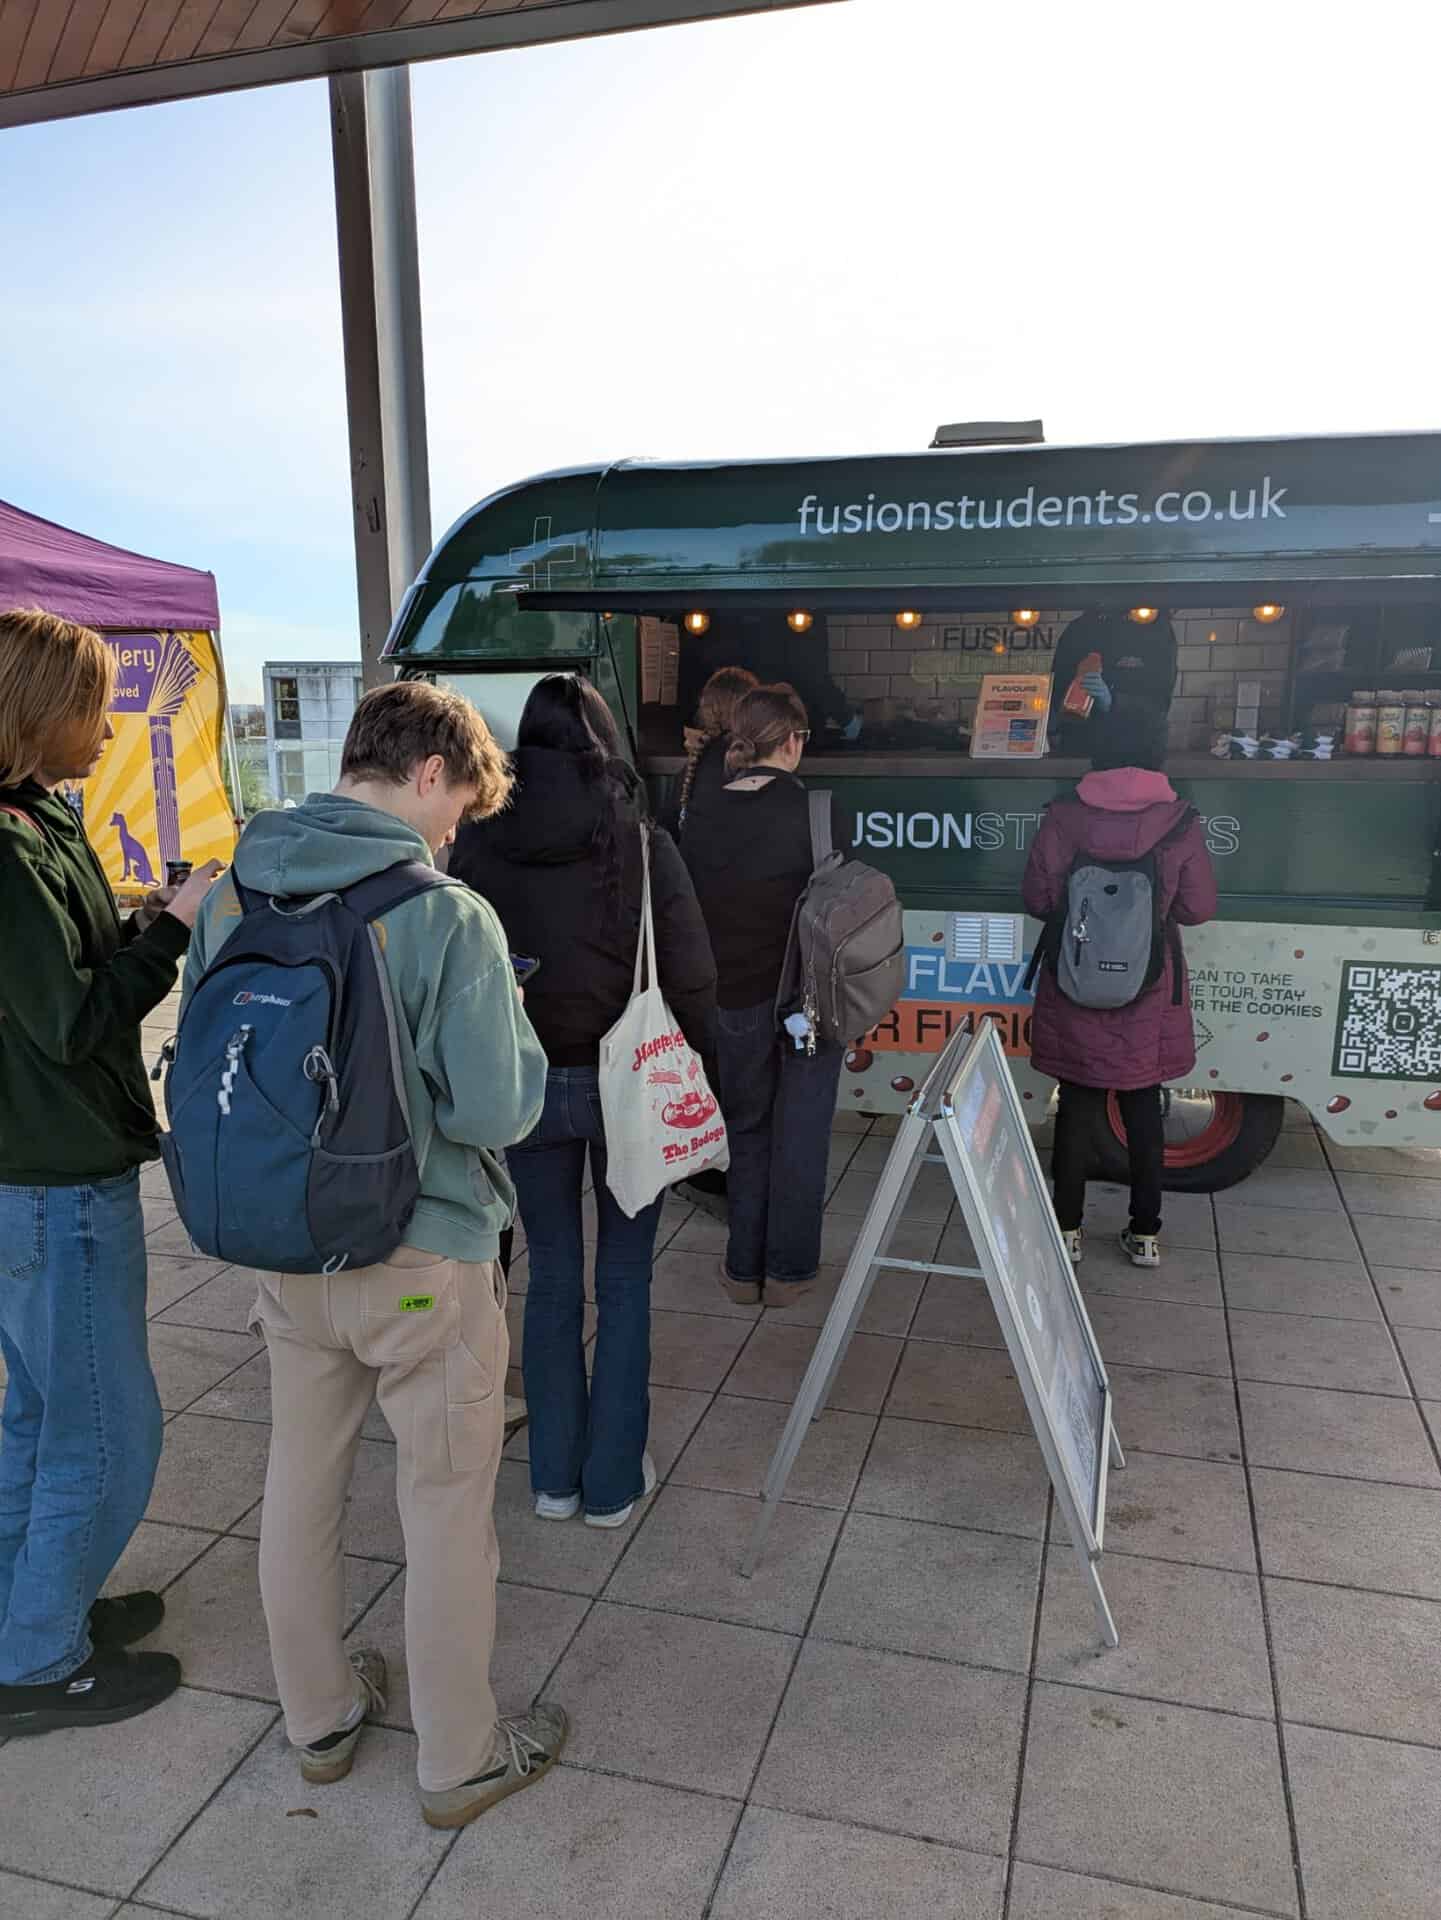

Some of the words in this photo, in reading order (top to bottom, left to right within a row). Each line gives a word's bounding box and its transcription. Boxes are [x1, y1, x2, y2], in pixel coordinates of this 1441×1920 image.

[797, 475, 1289, 535] fusionstudents.co.uk
[943, 626, 1054, 651] FUSION
[909, 954, 1037, 998] FLAV
[1186, 968, 1219, 982] CAN
[1223, 971, 1246, 984] TO
[1250, 971, 1295, 986] TAKE
[1262, 988, 1306, 1002] STAY
[1209, 1000, 1242, 1013] THE
[1246, 1001, 1323, 1018] COOKIES
